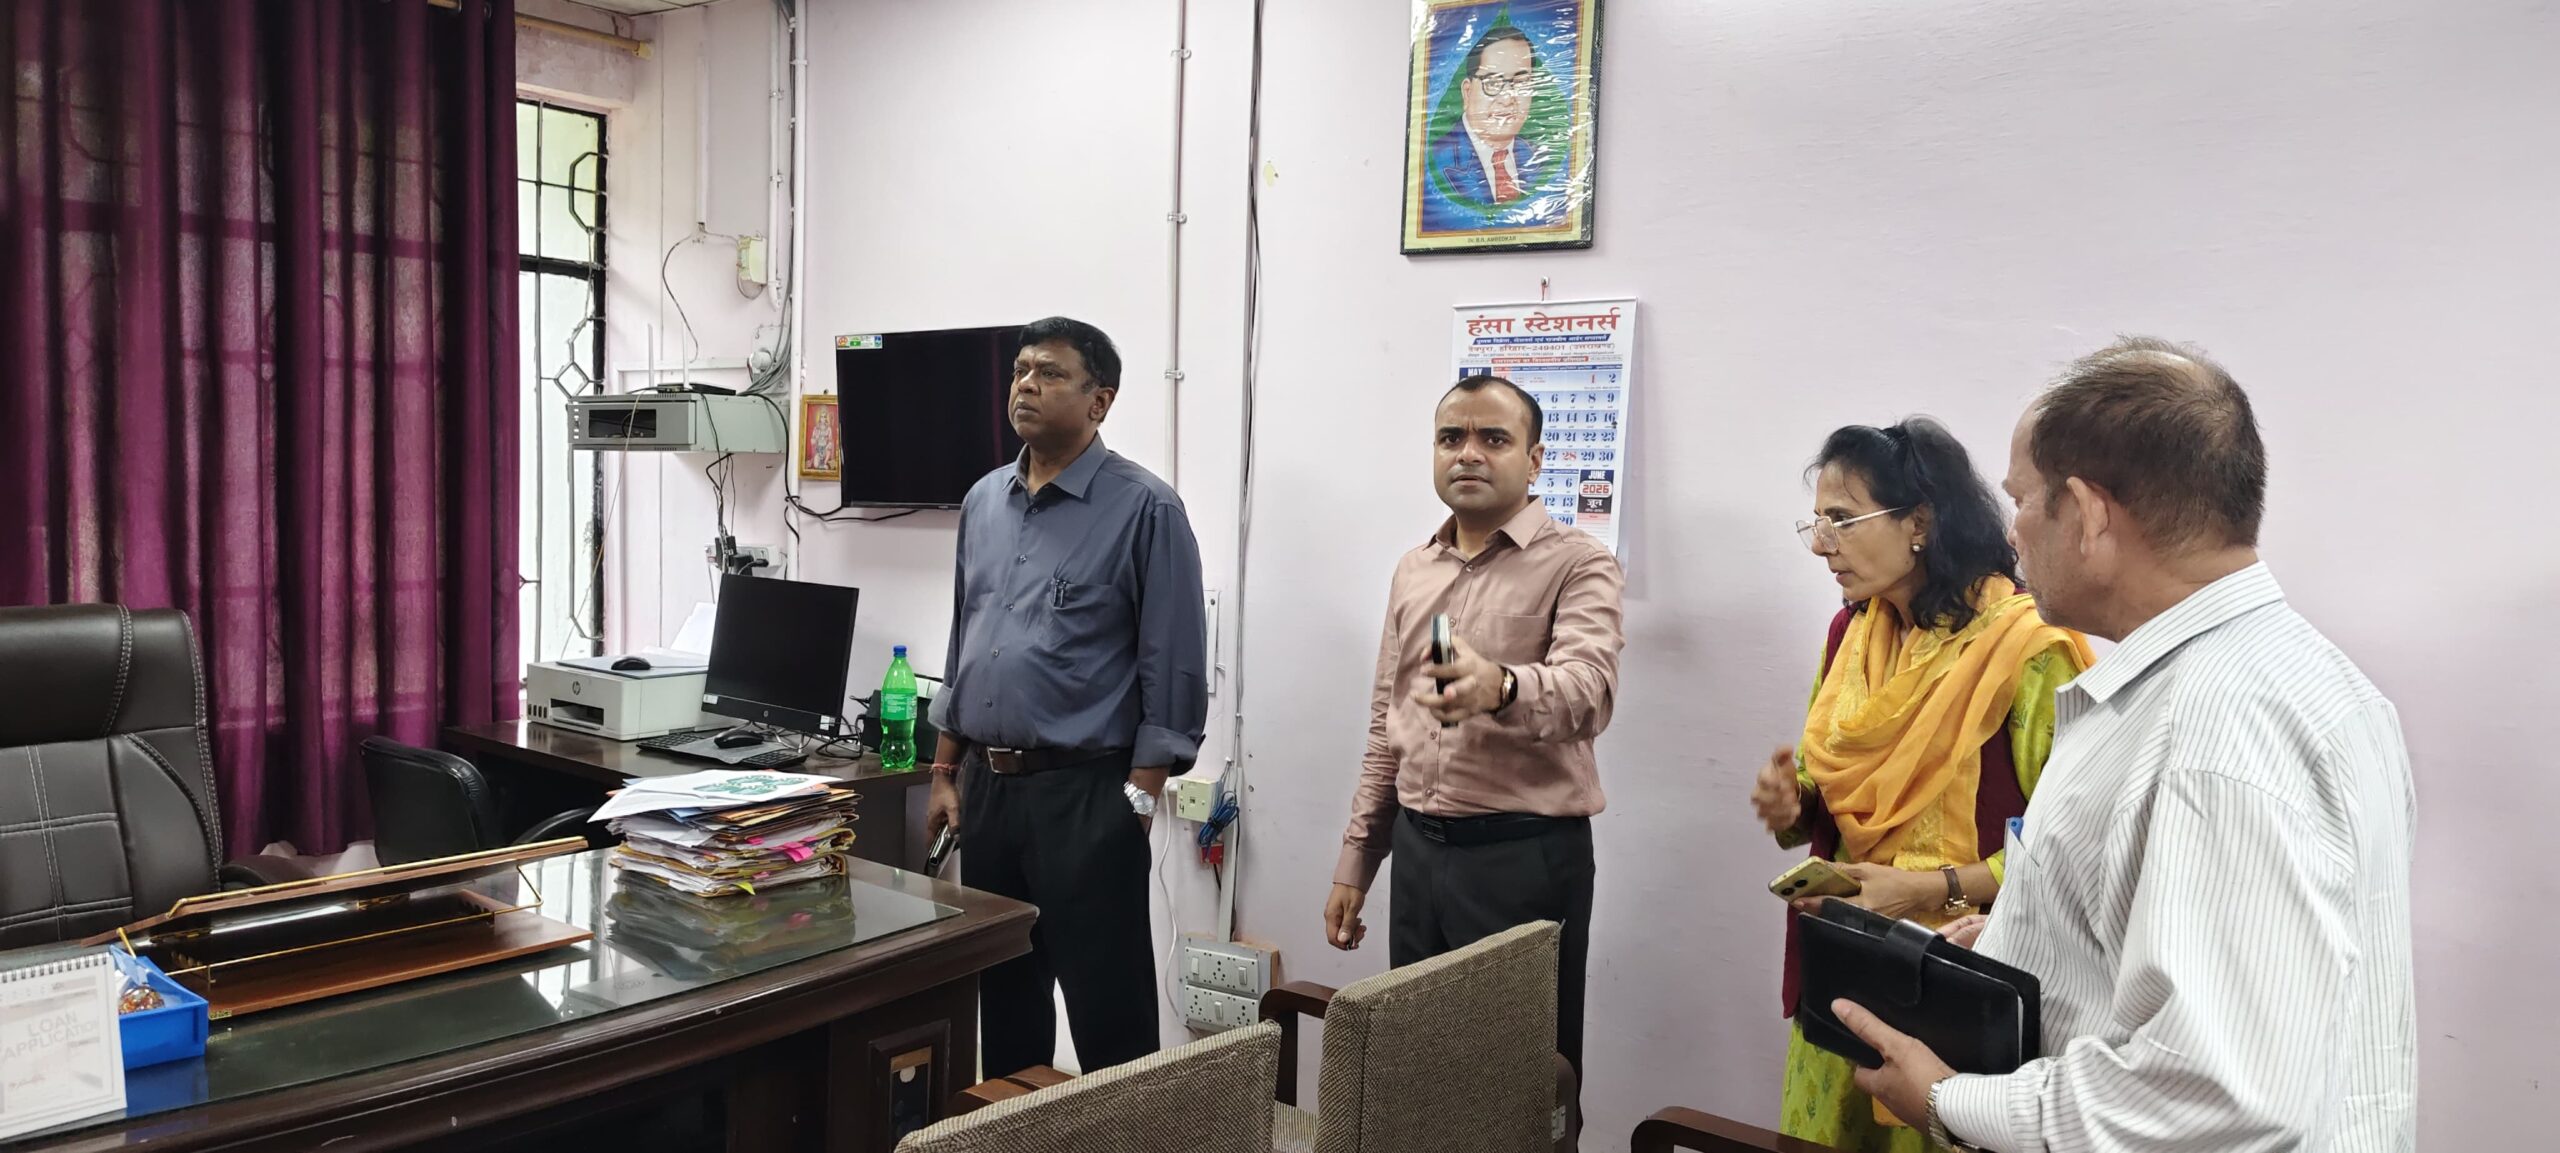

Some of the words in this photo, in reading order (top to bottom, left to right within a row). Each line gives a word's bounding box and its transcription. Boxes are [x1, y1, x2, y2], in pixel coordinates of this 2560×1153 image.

[1466, 315, 1516, 337] हंसा
[1523, 307, 1621, 333] स्टेशनर्स
[1468, 367, 1483, 376] MAY
[1591, 374, 1596, 384] 1
[1609, 373, 1616, 383] 2
[1551, 393, 1558, 403] 6
[1570, 393, 1576, 403] 7
[1588, 392, 1596, 404] 8
[1607, 392, 1615, 403] 9
[1548, 412, 1559, 423] 13
[1567, 412, 1577, 423] 14
[1585, 412, 1597, 423] 15
[1604, 412, 1615, 423] 16
[1545, 431, 1559, 442] 20
[1564, 431, 1576, 442] 21
[1583, 431, 1597, 442] 22
[1601, 431, 1615, 442] 23
[1545, 451, 1558, 461] 27
[1562, 451, 1577, 461] 28
[1581, 450, 1595, 461] 29
[1599, 450, 1614, 461] 30
[1588, 470, 1606, 480] JUNE
[1547, 477, 1554, 488] 5
[1565, 477, 1573, 488] 6
[1582, 484, 1610, 494] 2026
[1544, 496, 1555, 507] 12
[1562, 496, 1573, 507] 13
[28, 1010, 78, 1037] LOAN
